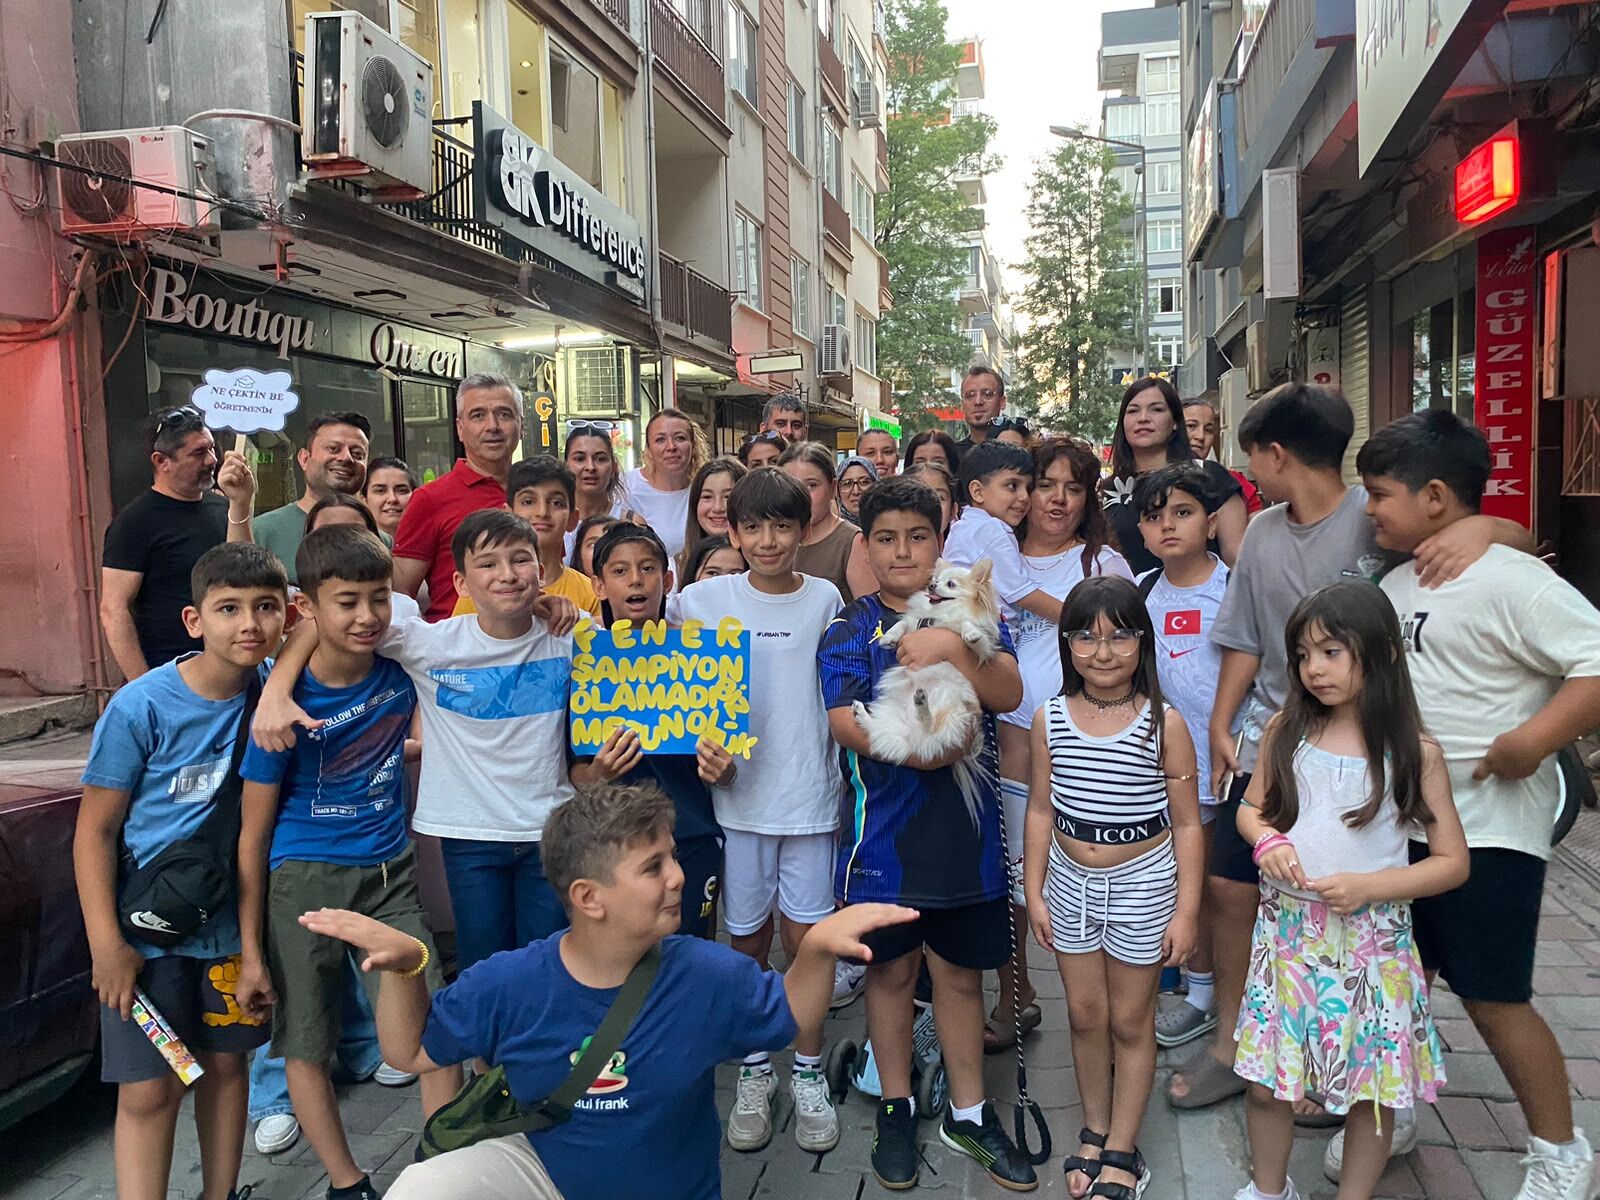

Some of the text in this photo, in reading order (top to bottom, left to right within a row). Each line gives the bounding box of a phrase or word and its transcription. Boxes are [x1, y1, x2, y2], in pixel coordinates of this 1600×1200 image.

[549, 174, 645, 280] Difference
[211, 386, 284, 401] NE ÇEKTİN BE
[1482, 288, 1528, 496] GÜZELLİK
[572, 616, 743, 653] FENER
[432, 673, 467, 685] NATURE
[571, 651, 743, 690] ŞAMPİYON
[322, 708, 352, 728] OLLOW
[168, 772, 224, 794] JUST
[1056, 815, 1149, 843] ON ICON
[595, 1096, 630, 1110] frank
